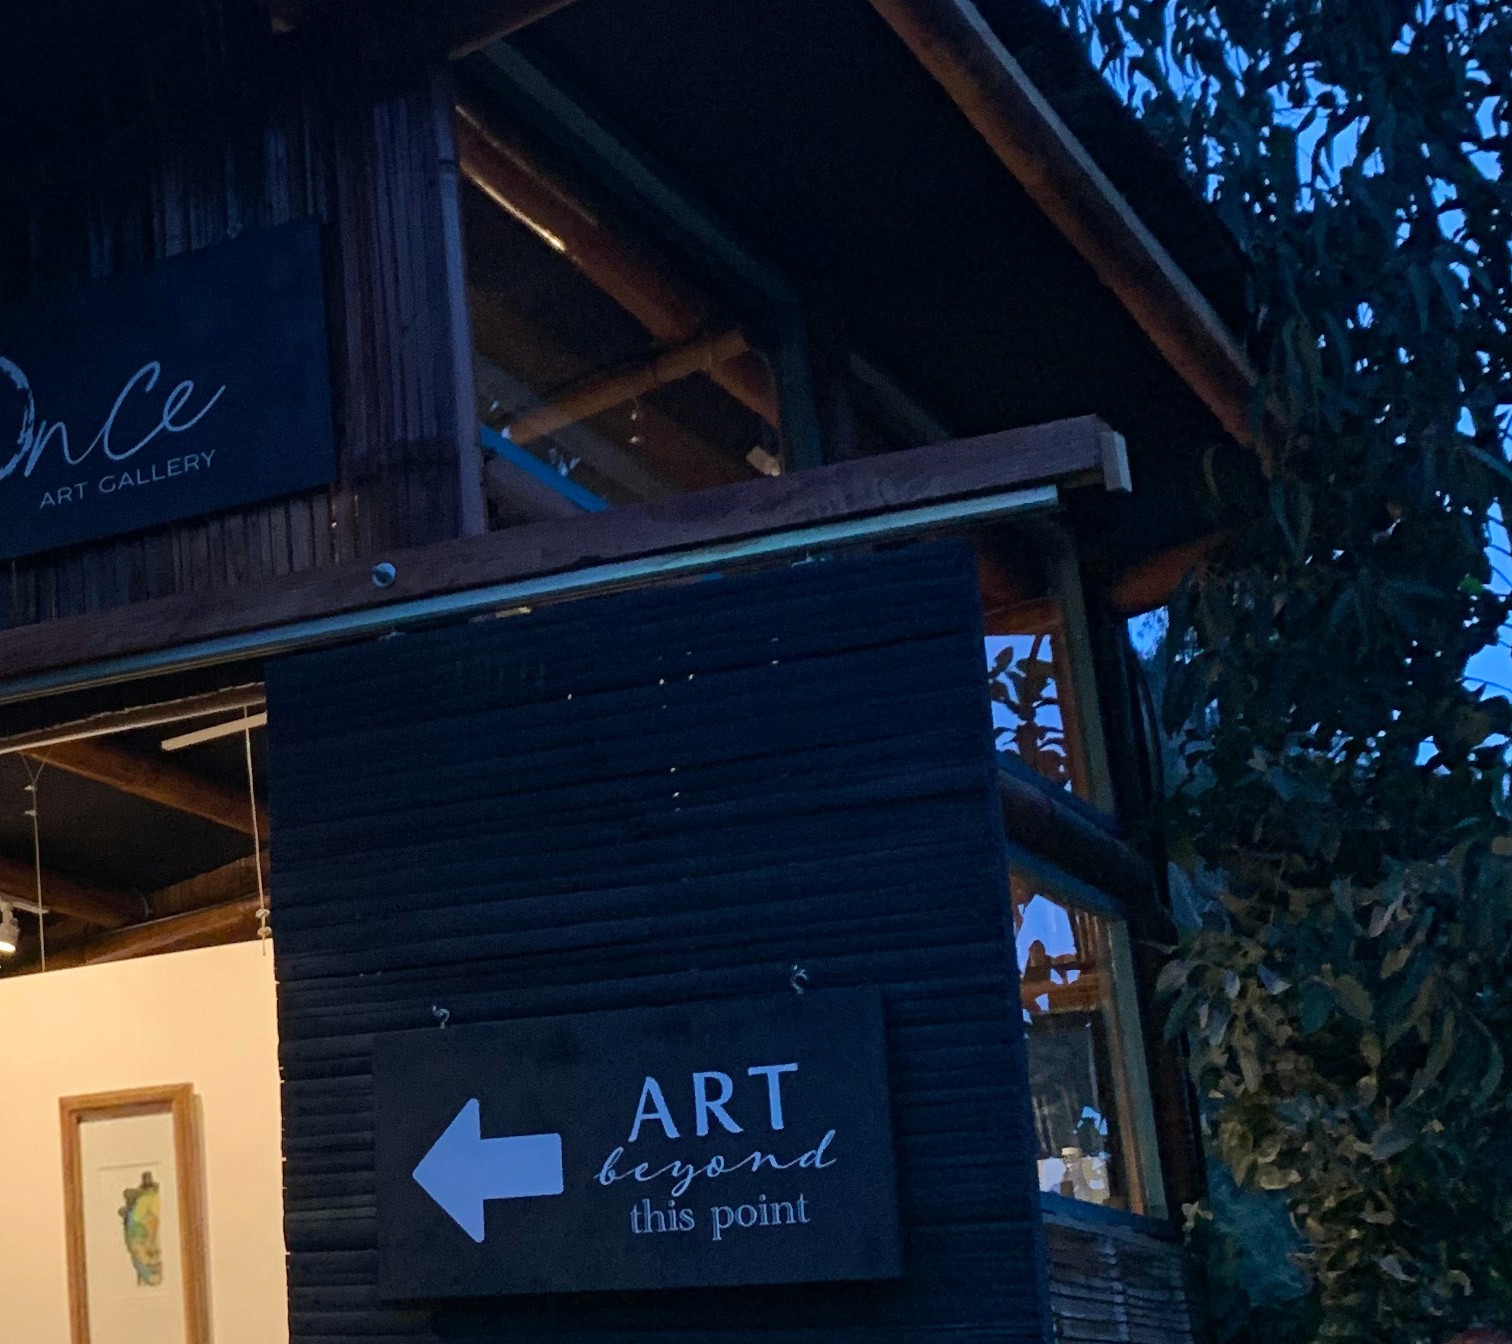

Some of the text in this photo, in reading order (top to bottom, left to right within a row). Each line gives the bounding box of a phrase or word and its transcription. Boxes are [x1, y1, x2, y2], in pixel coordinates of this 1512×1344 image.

[39, 449, 217, 509] ART GALLERY
[628, 1062, 798, 1141] ART
[593, 1129, 837, 1196] beyond
[630, 1192, 810, 1241] this point
